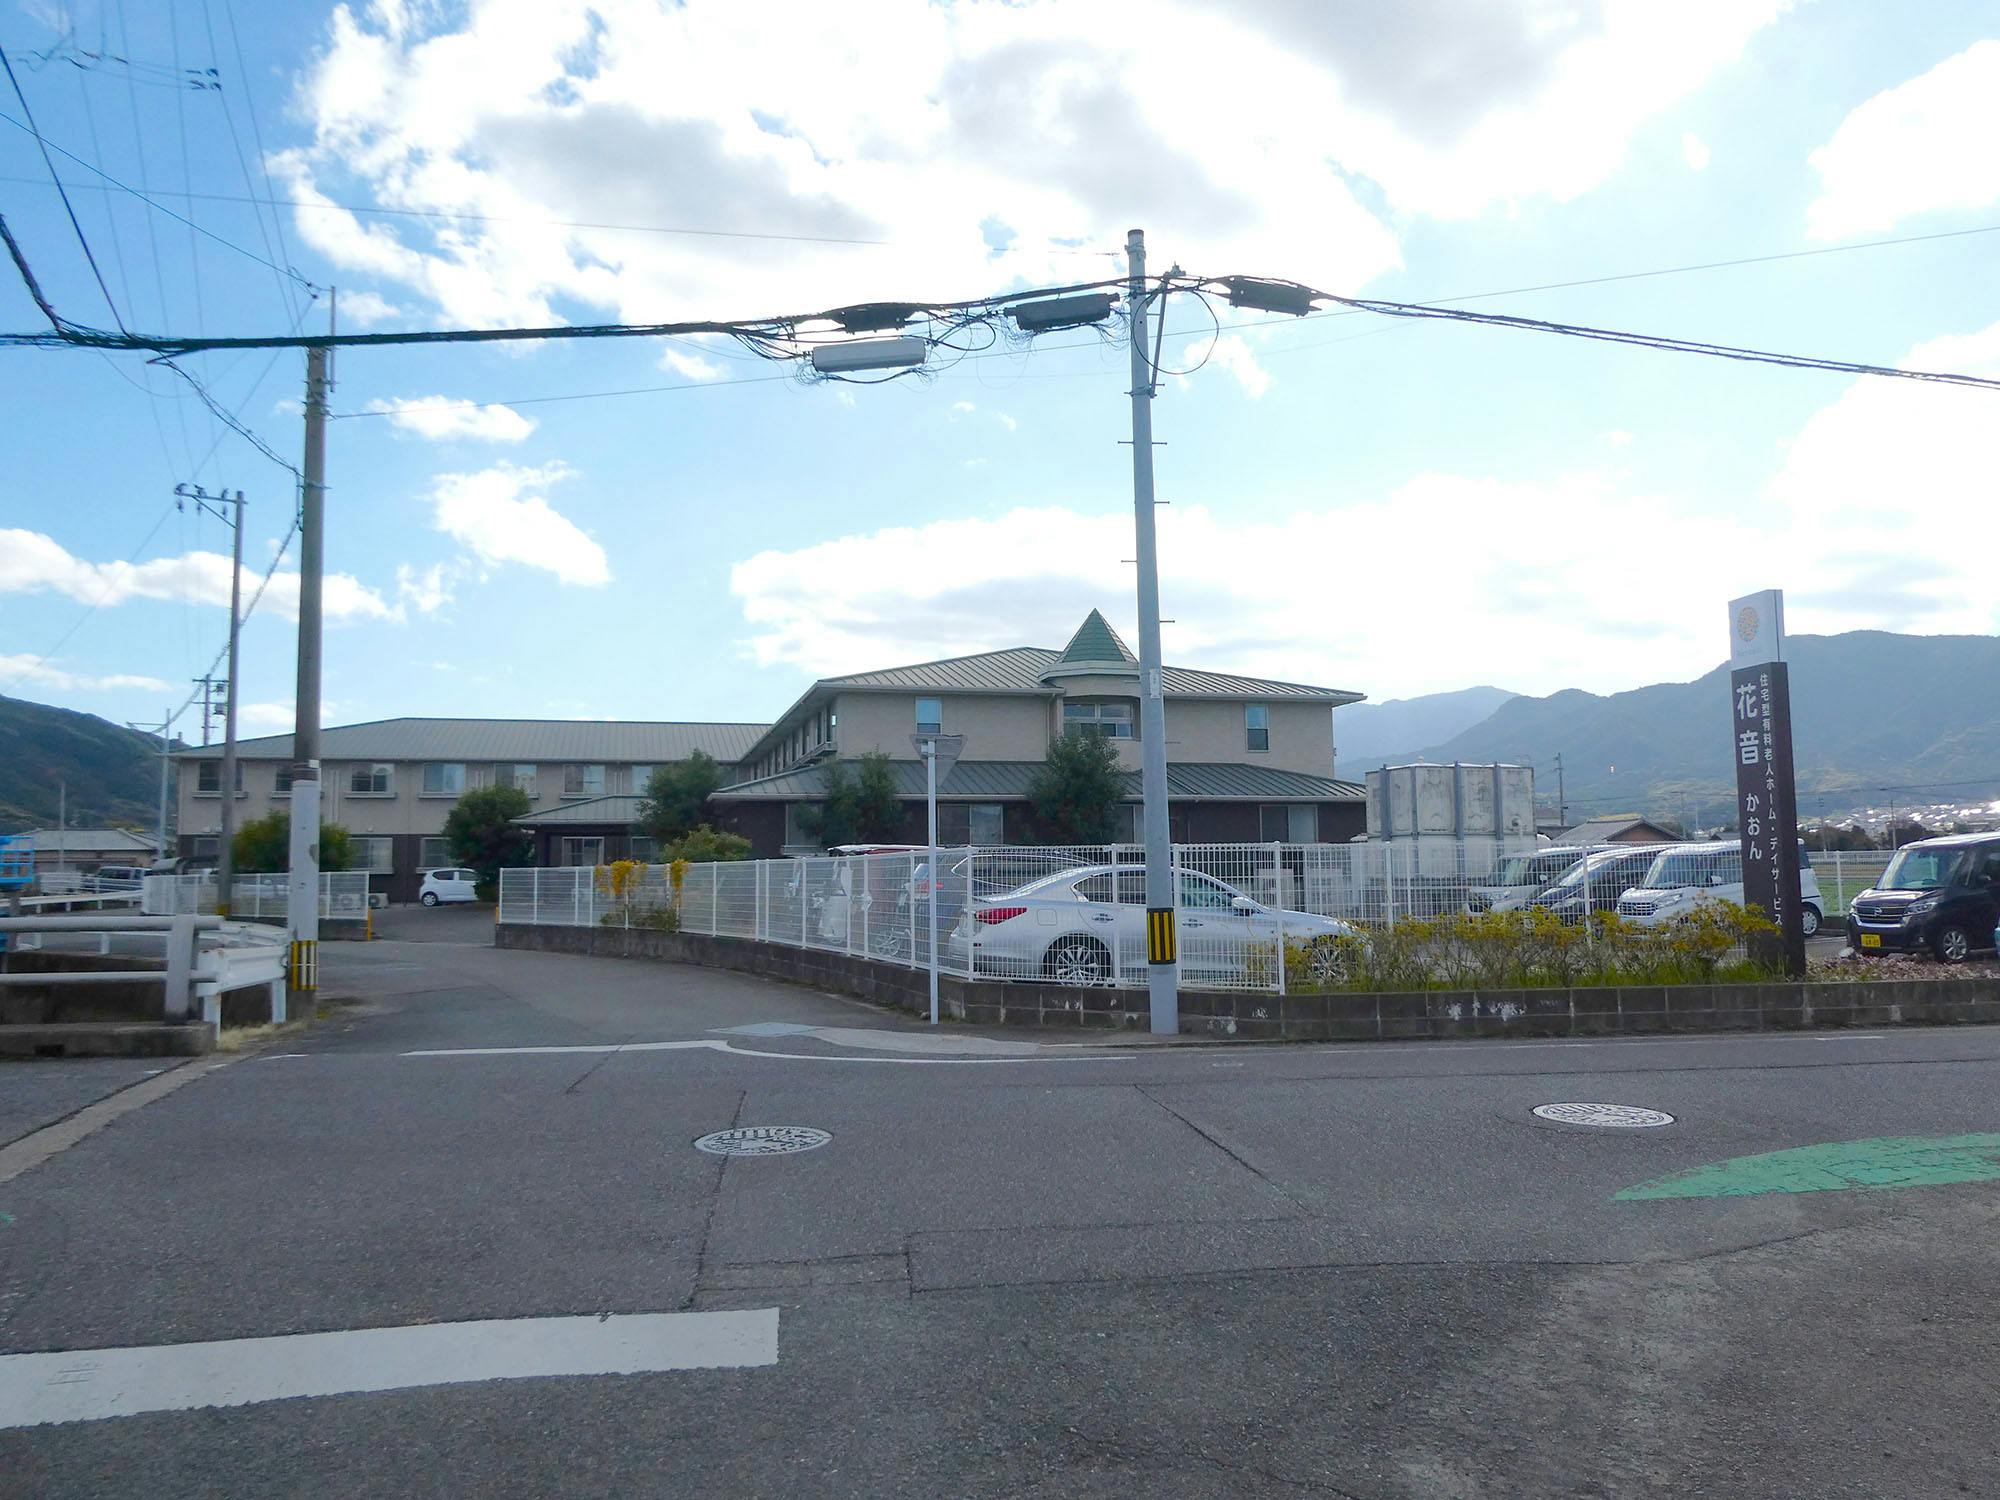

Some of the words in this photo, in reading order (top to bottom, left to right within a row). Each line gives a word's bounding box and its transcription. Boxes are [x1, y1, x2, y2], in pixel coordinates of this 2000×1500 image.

[1736, 682, 1759, 765] 花音
[1746, 792, 1762, 860] かおん
